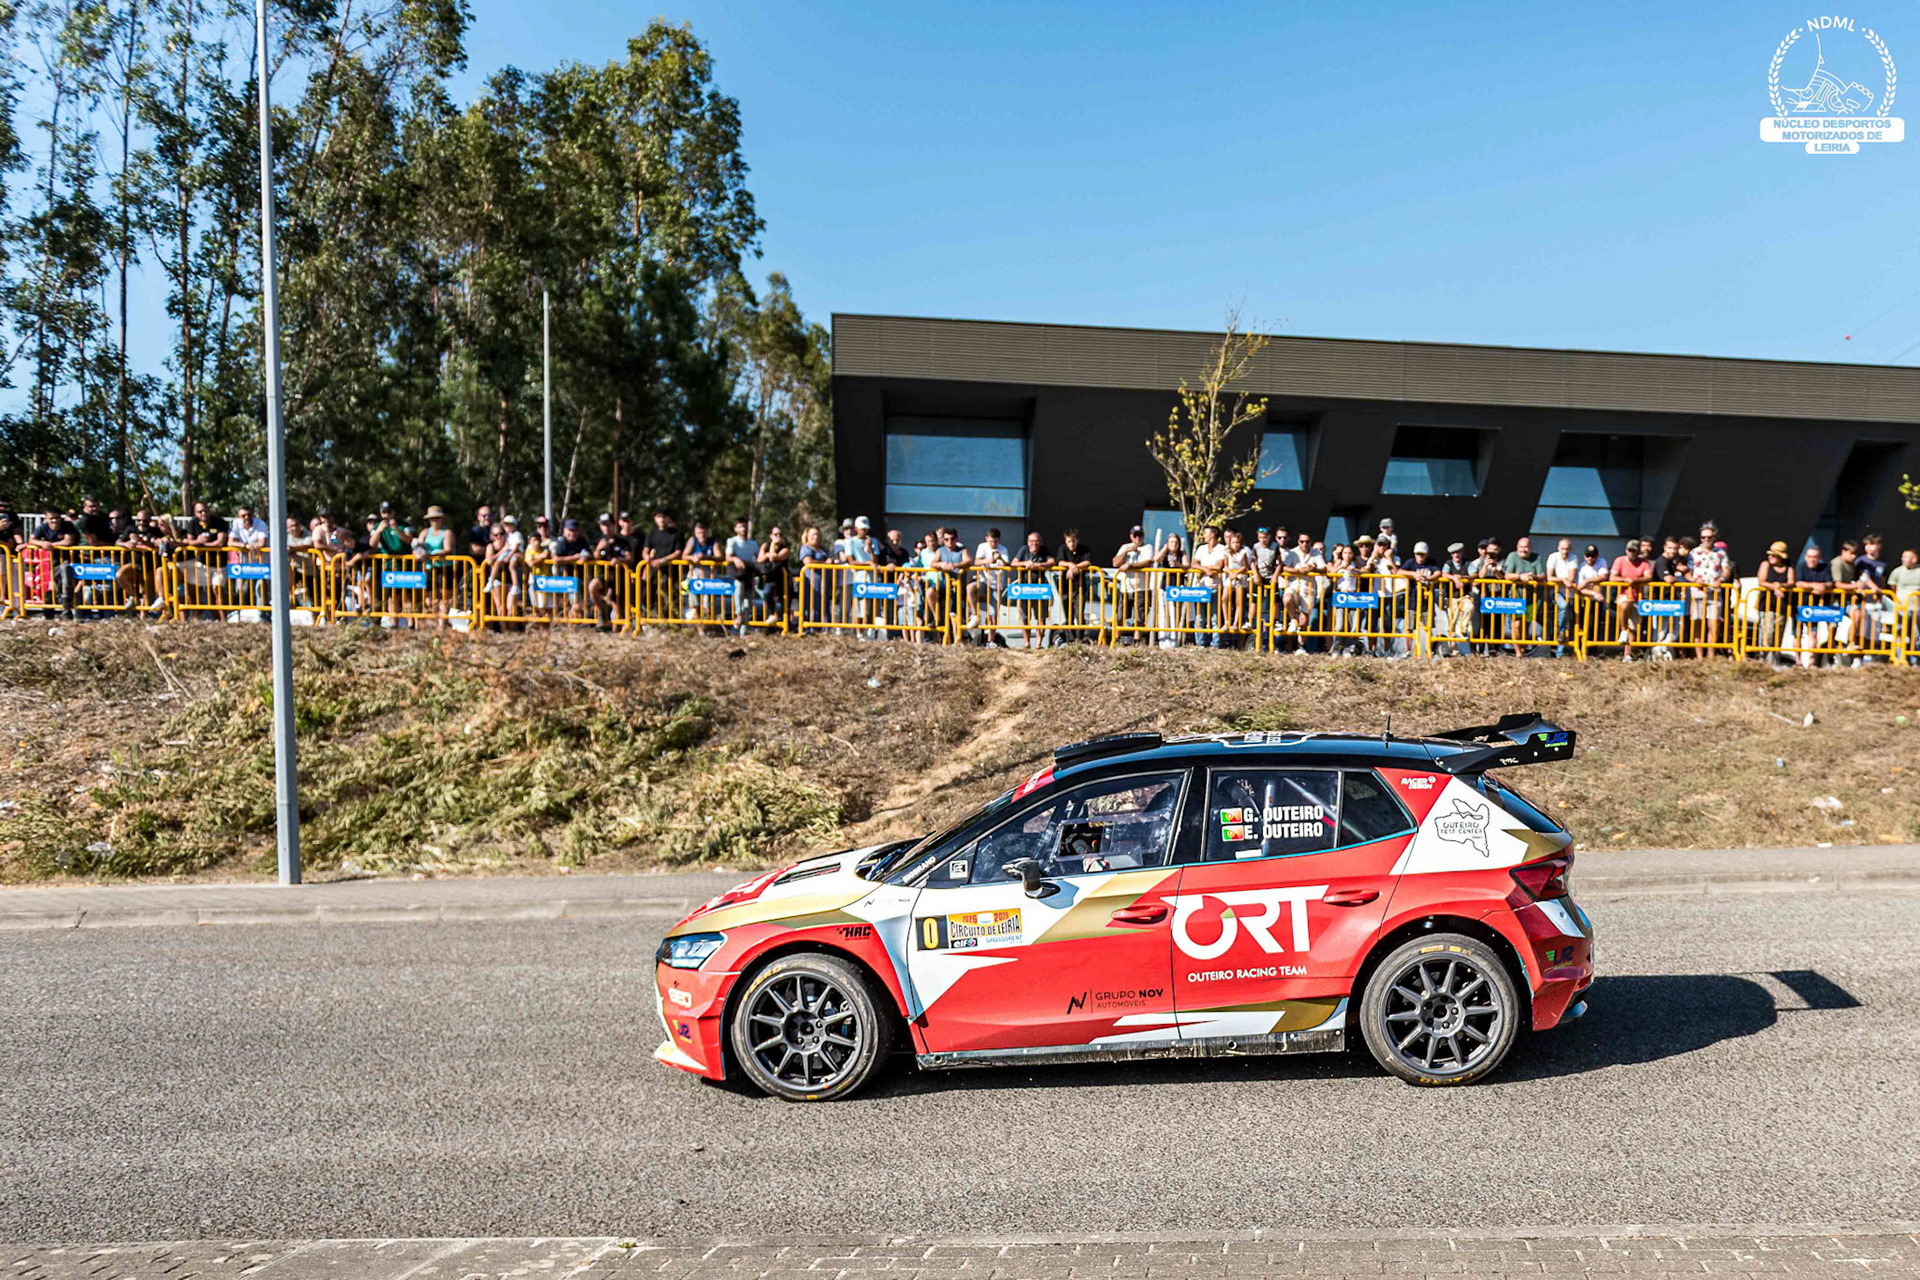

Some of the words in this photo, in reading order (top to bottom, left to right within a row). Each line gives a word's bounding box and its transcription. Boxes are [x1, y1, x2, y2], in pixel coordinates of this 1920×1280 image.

[1243, 809, 1259, 822] G.
[1262, 805, 1325, 822] OUTEIRO
[1244, 825, 1259, 840] E.
[1262, 822, 1324, 839] OUTEIRO
[1442, 821, 1480, 829] OUTEIRO
[950, 921, 986, 938] CIRCUITO
[987, 925, 997, 935] DE
[997, 914, 1021, 934] LEIRIA
[1160, 885, 1329, 960] ORT
[922, 917, 939, 949] 0
[953, 938, 968, 948] elf
[1187, 969, 1234, 983] OUTEIRO
[1236, 967, 1277, 979] RACING
[1279, 965, 1307, 976] TEAM
[1095, 989, 1136, 1001] GRUPO
[1138, 988, 1164, 998] NOV
